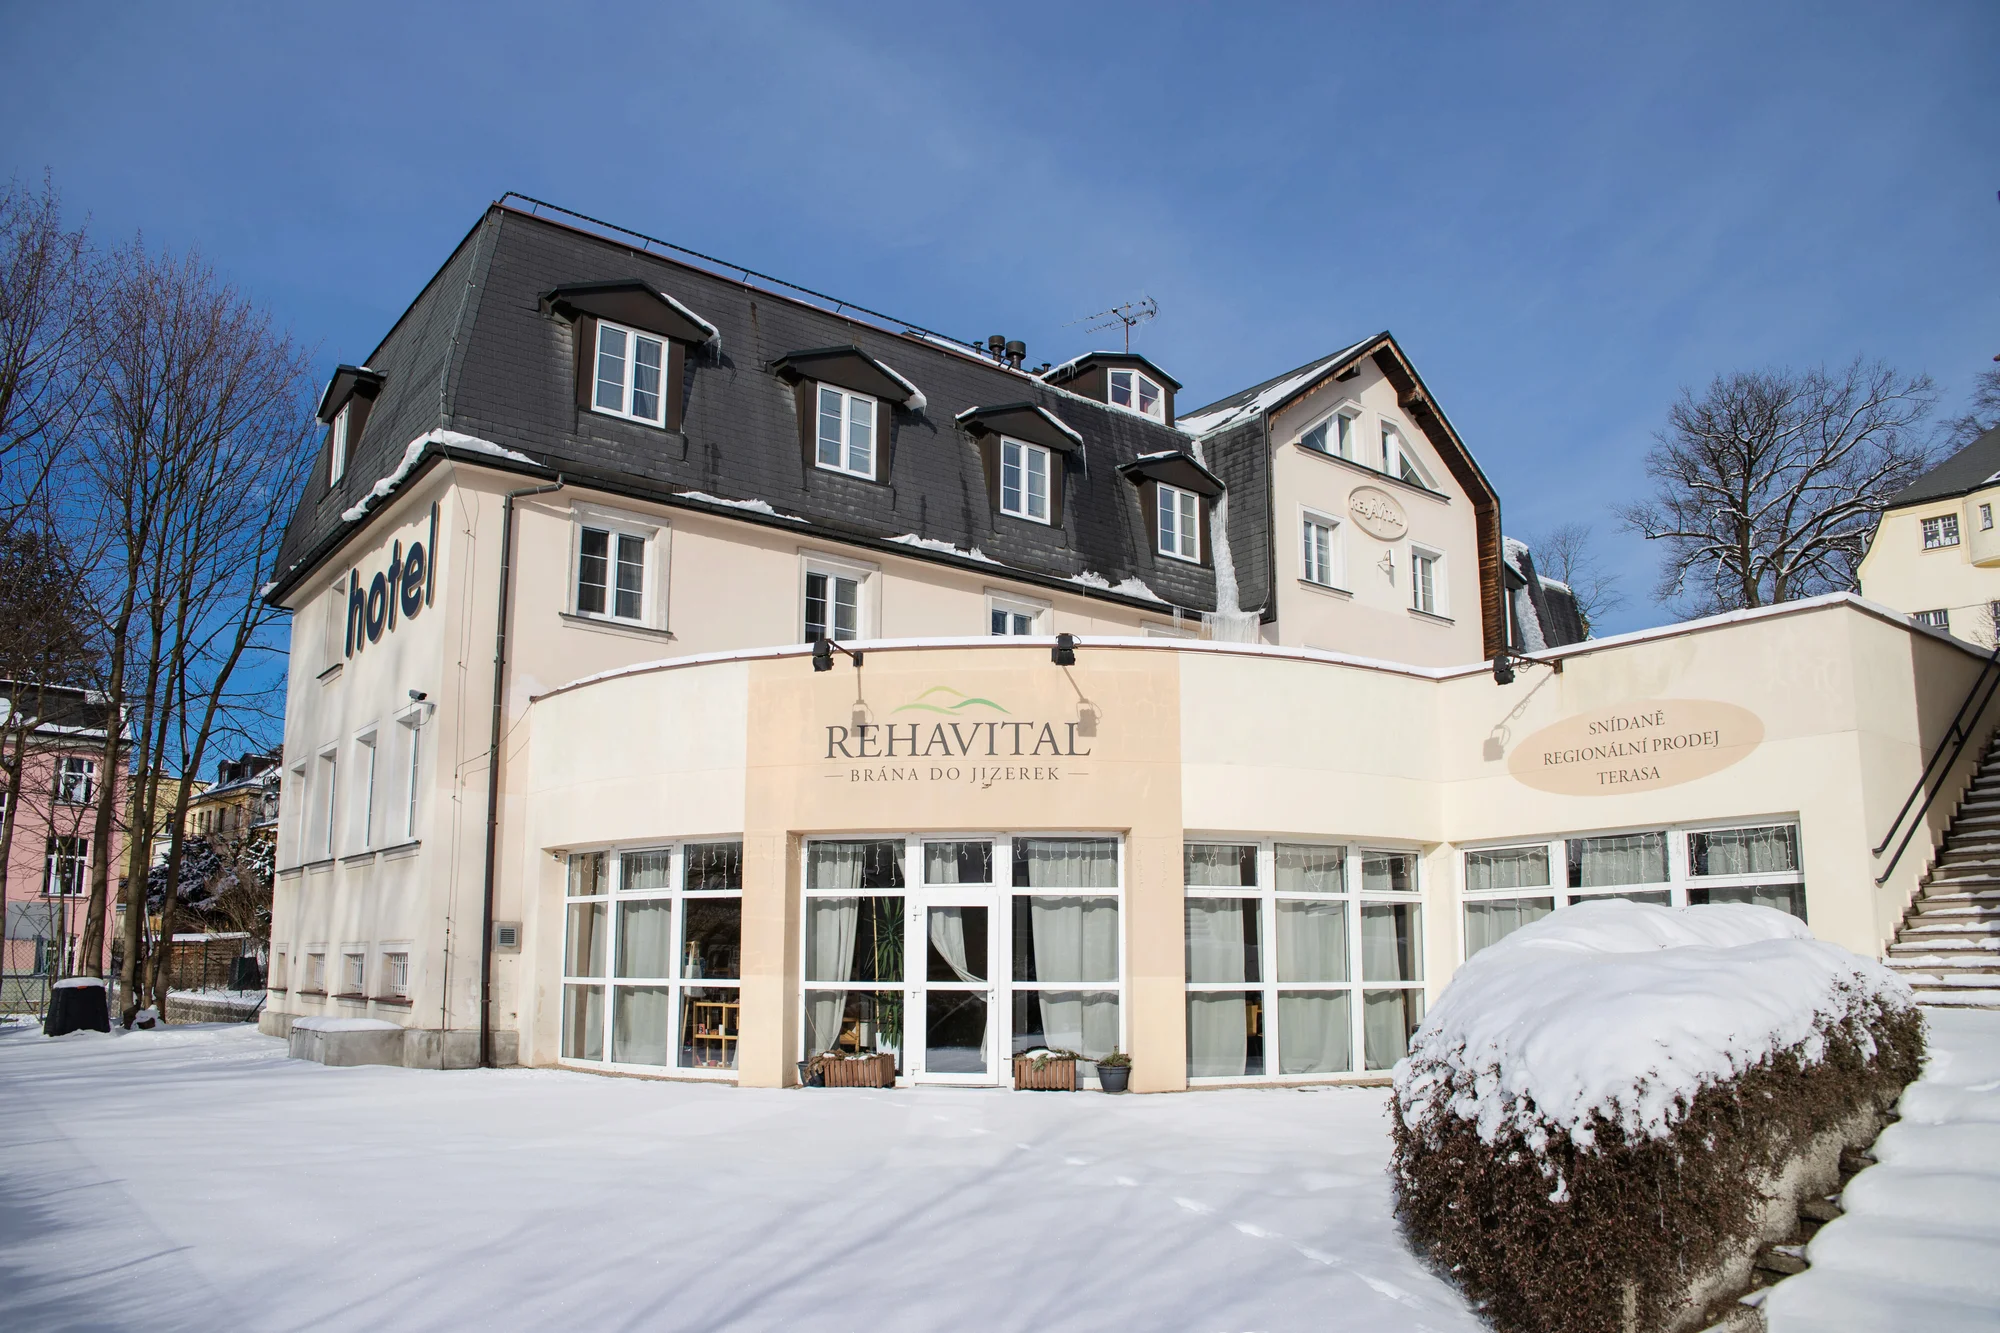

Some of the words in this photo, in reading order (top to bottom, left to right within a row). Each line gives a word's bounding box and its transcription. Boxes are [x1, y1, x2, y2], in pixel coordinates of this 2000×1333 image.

[345, 500, 438, 658] hotel
[1588, 710, 1666, 735] SNÍDANĚ
[824, 721, 1092, 759] REHAVITAL
[1543, 737, 1648, 765] REGIONÁLNÍ
[1653, 730, 1720, 752] PRODEJ
[850, 765, 919, 782] BRÁNA
[929, 766, 960, 781] DO
[970, 766, 1060, 784] JIZEREK
[1596, 766, 1661, 785] TERASA
